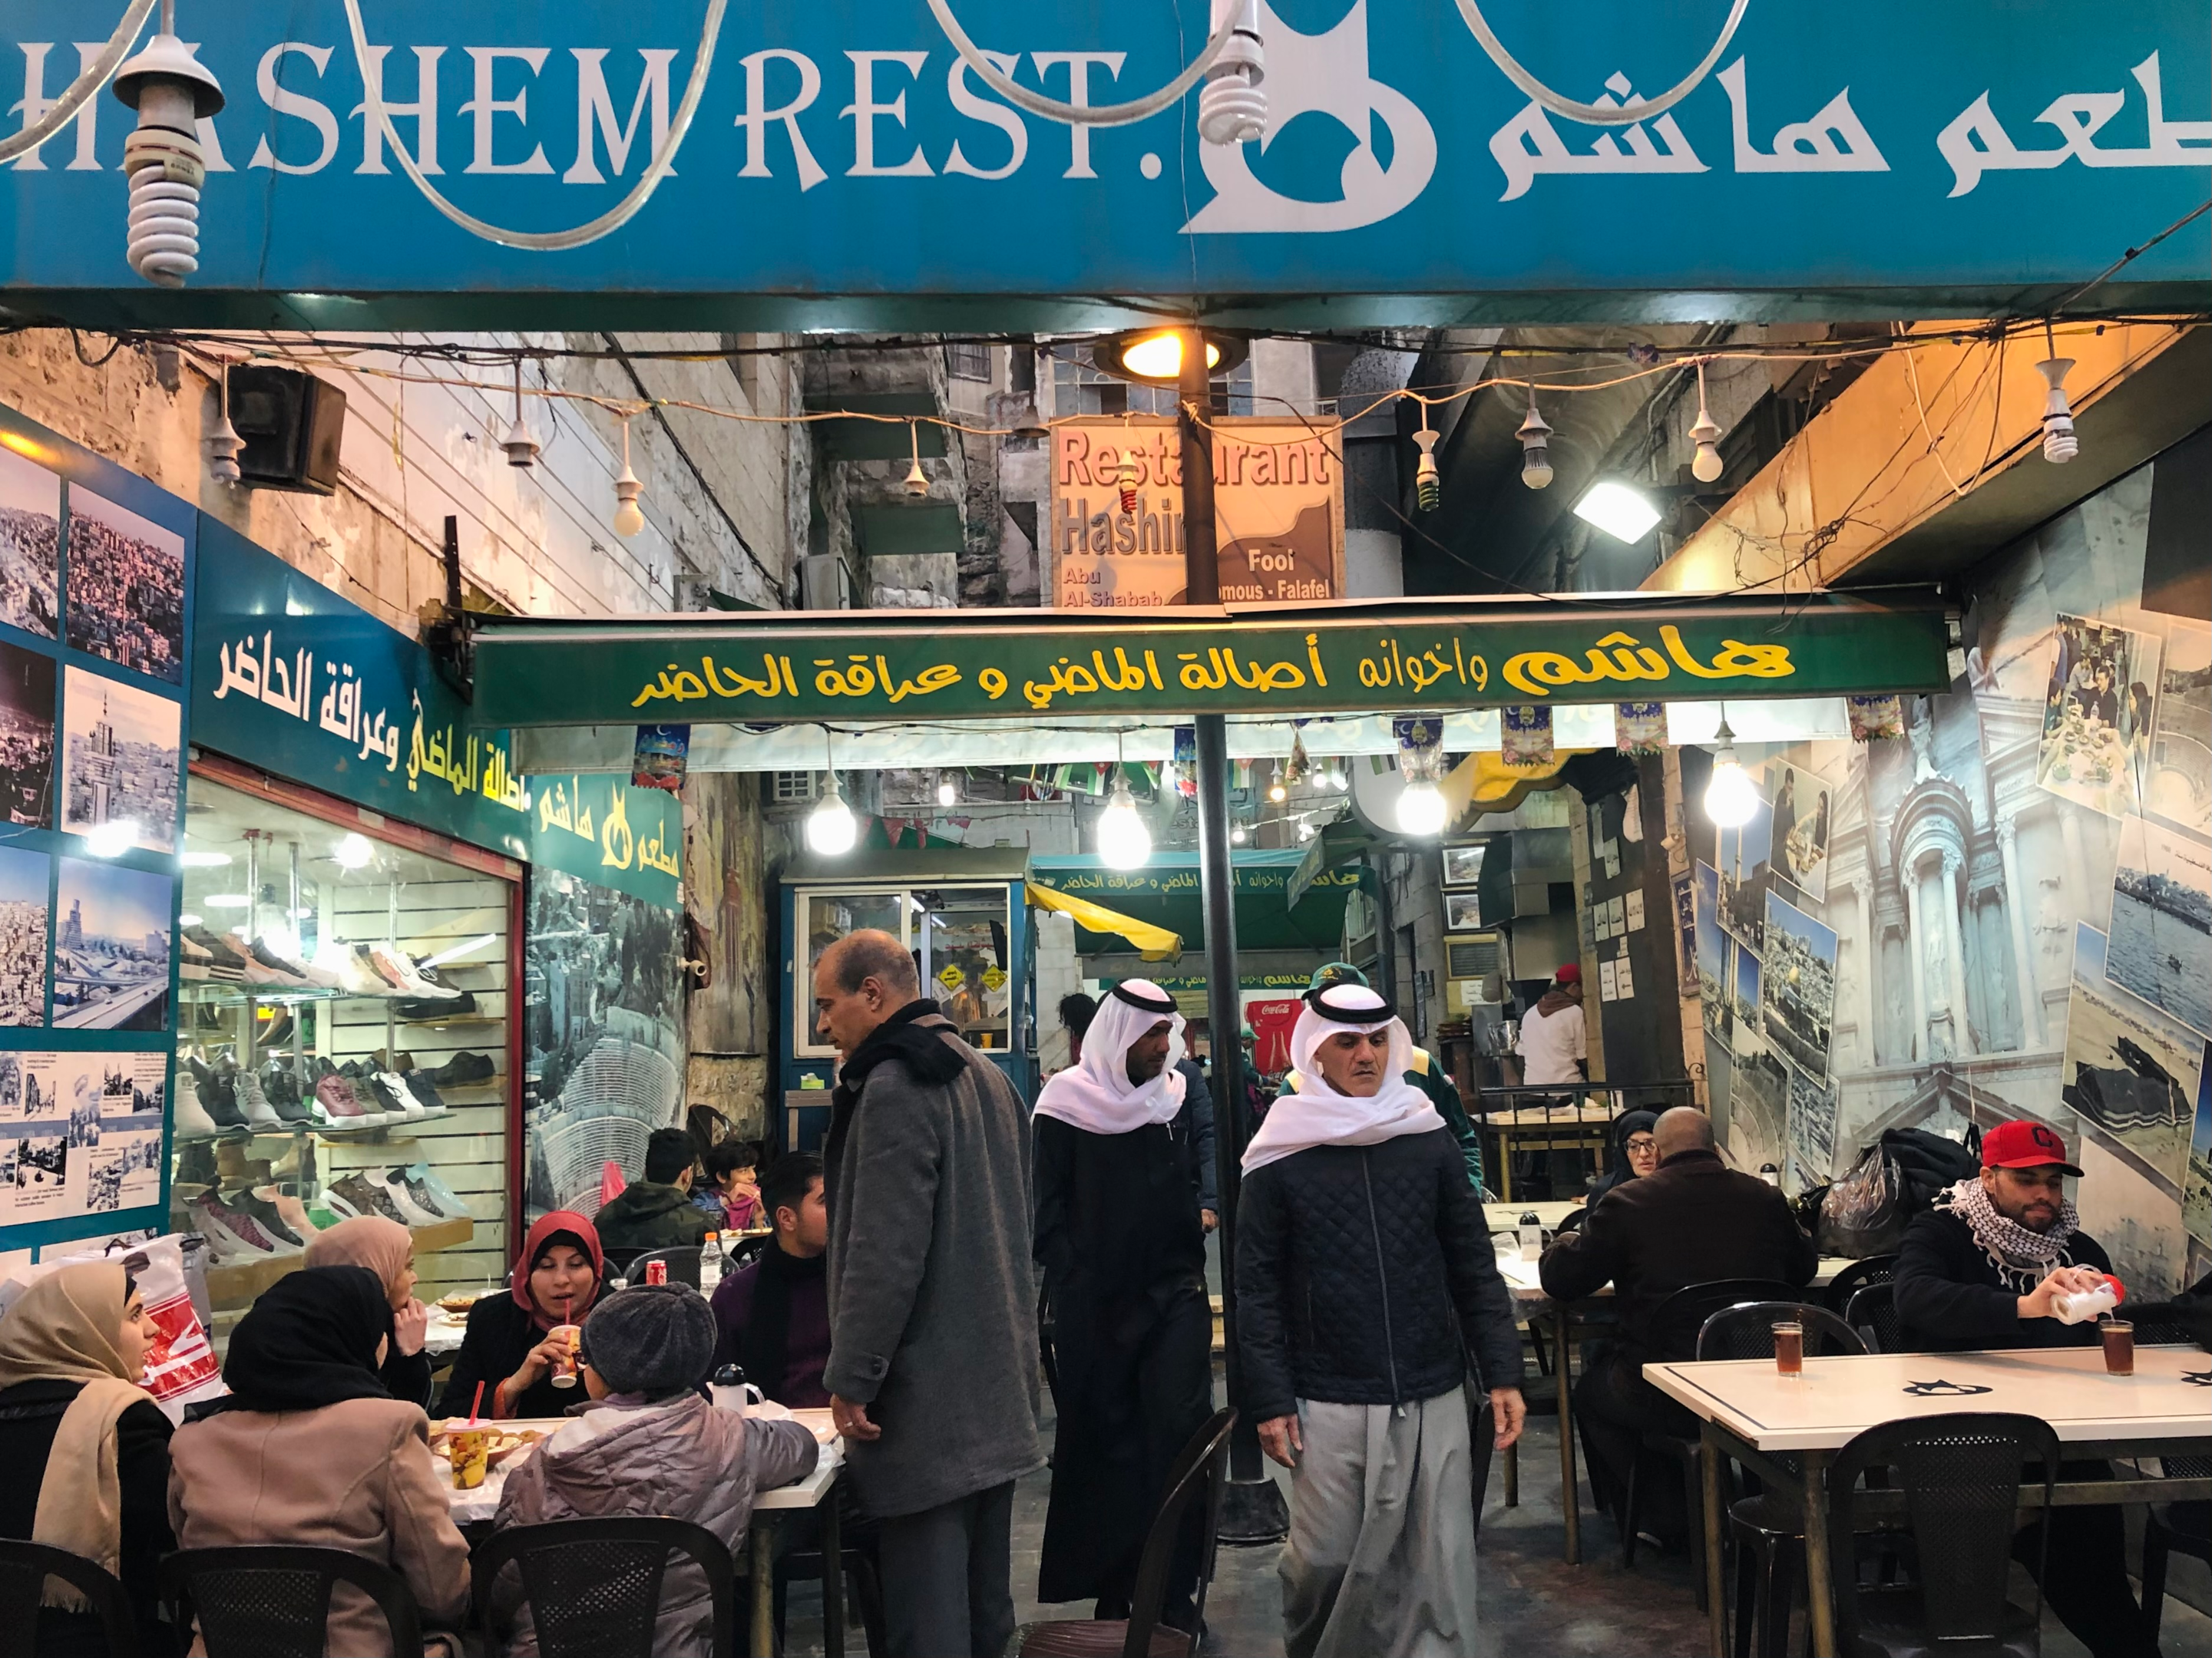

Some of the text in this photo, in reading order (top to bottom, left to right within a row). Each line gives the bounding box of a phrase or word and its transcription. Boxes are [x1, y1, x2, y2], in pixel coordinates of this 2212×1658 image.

[735, 48, 1162, 193] REST.
[1489, 54, 1892, 203] هاشم
[1059, 497, 1187, 555] Hashi
[1063, 568, 1101, 585] Abu
[1063, 590, 1163, 608] Al-Shabab
[1218, 585, 1264, 600] mous
[1277, 579, 1331, 599] Falafel
[213, 629, 313, 722] الحاضر
[630, 652, 799, 708] الحاضر
[812, 655, 964, 704] عراقة
[1023, 646, 1165, 709] الماضي
[1179, 633, 1329, 693] أصالة
[1502, 625, 1797, 696] هاشم
[319, 660, 400, 772] وعراقة
[538, 775, 680, 878] مطعم هاشم
[2032, 1126, 2054, 1148] C
